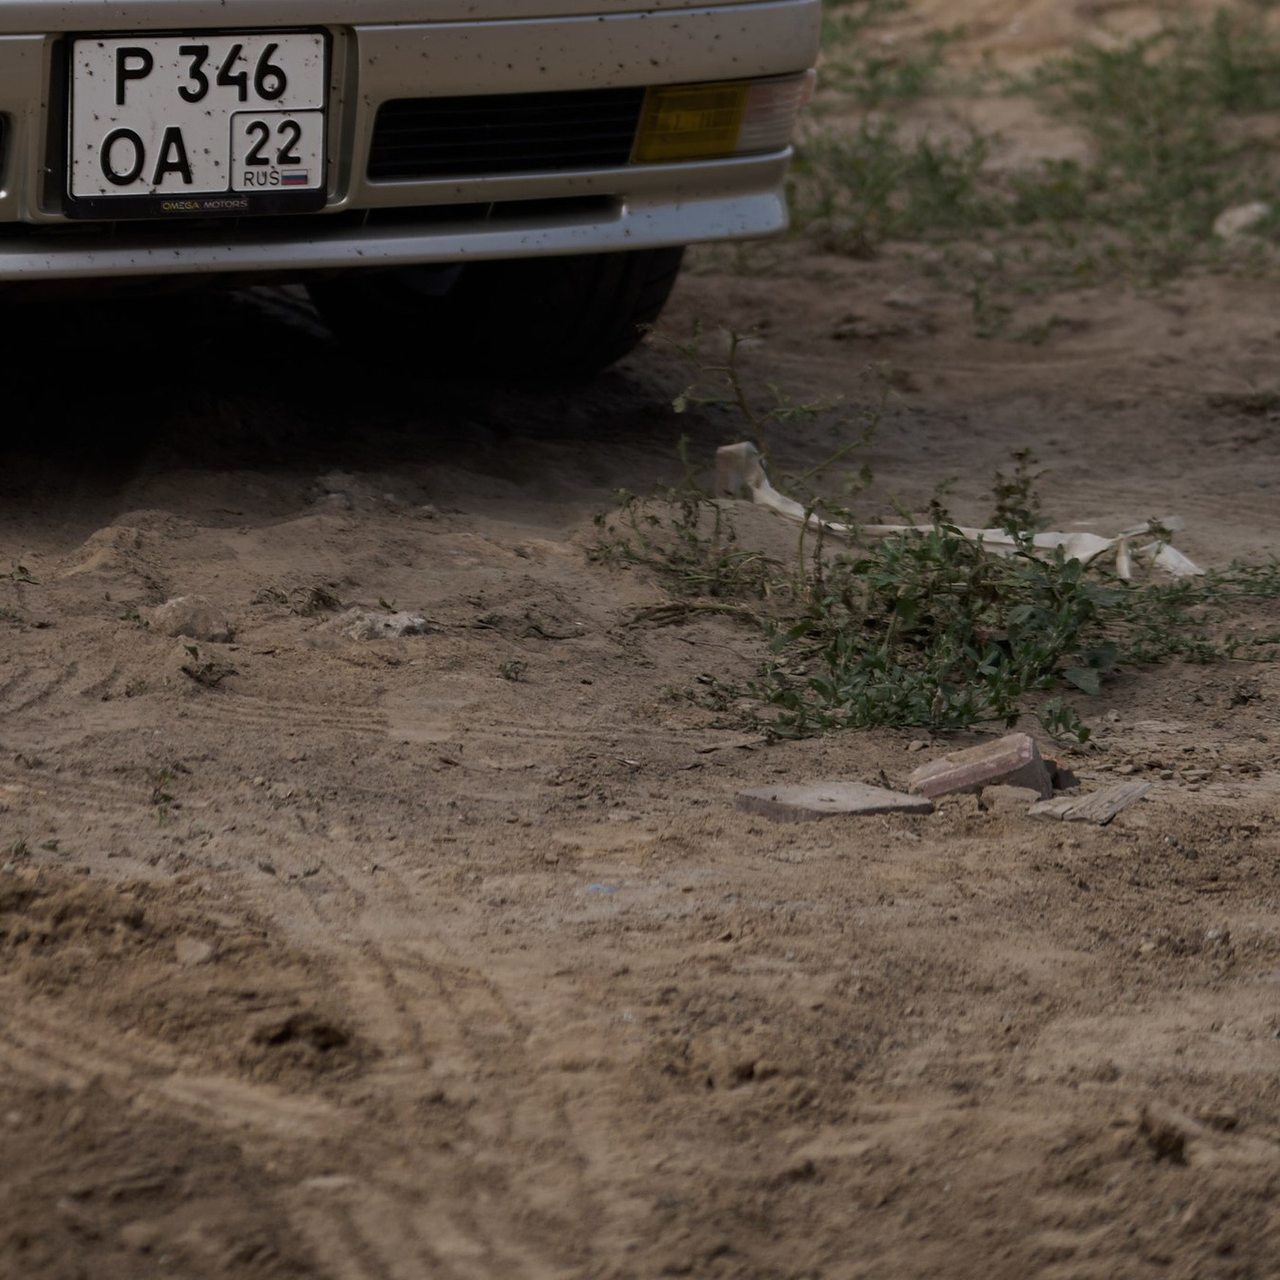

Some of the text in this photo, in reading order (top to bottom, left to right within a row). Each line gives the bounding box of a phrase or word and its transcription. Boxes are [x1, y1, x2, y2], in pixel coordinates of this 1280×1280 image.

[177, 43, 288, 104] 346
[245, 120, 302, 166] 22
[243, 171, 280, 187] RUS
[162, 199, 248, 211] OMEGA MOTORS
